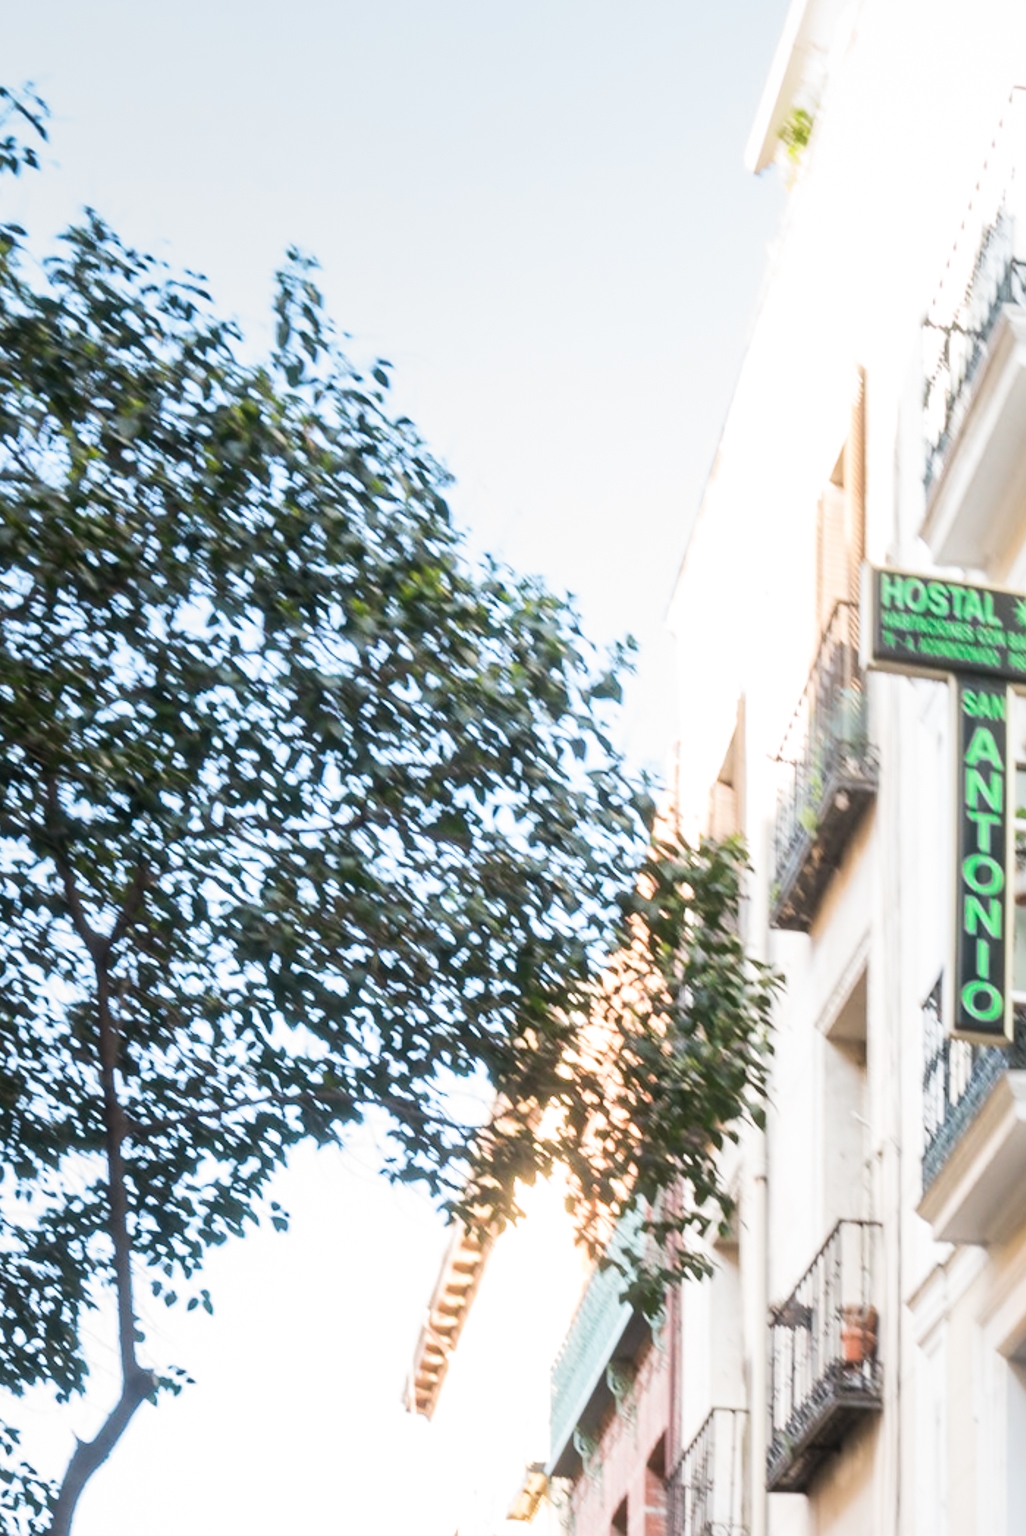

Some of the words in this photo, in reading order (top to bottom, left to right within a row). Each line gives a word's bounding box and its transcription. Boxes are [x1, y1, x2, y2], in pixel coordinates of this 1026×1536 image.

[881, 572, 1003, 628] HOSTAL
[962, 689, 1006, 721] SAN
[962, 726, 1004, 1021] ANTONIO
